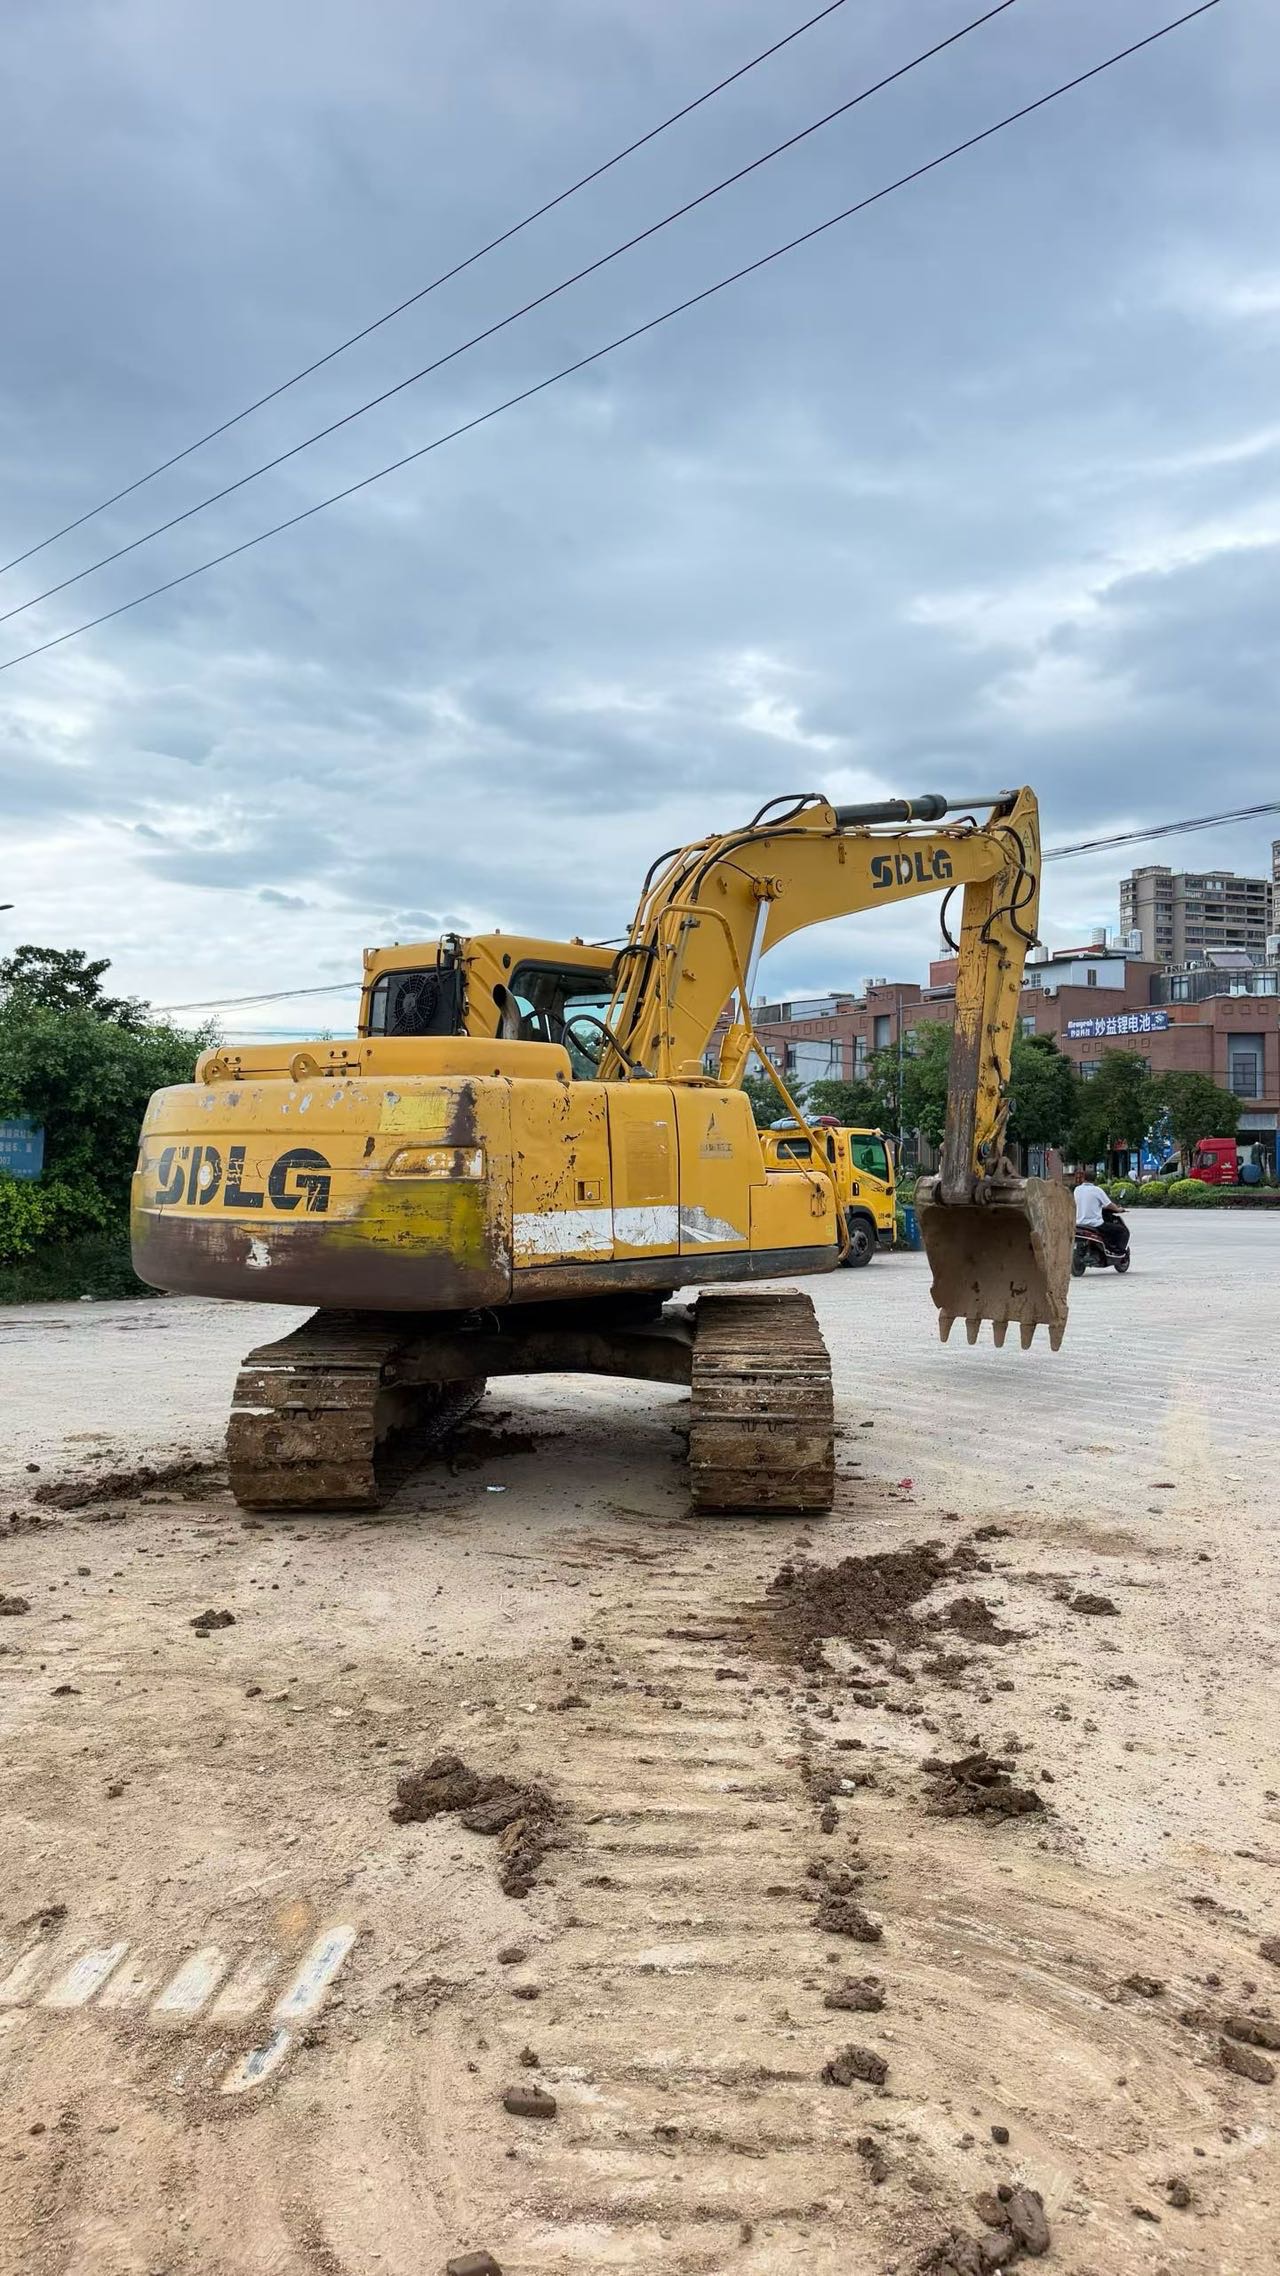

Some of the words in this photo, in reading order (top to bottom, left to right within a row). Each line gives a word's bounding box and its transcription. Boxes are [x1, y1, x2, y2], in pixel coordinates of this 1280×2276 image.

[871, 849, 953, 888] SDLG
[1095, 1013, 1150, 1037] 妙益锂电池
[155, 1145, 331, 1212] SDLG
